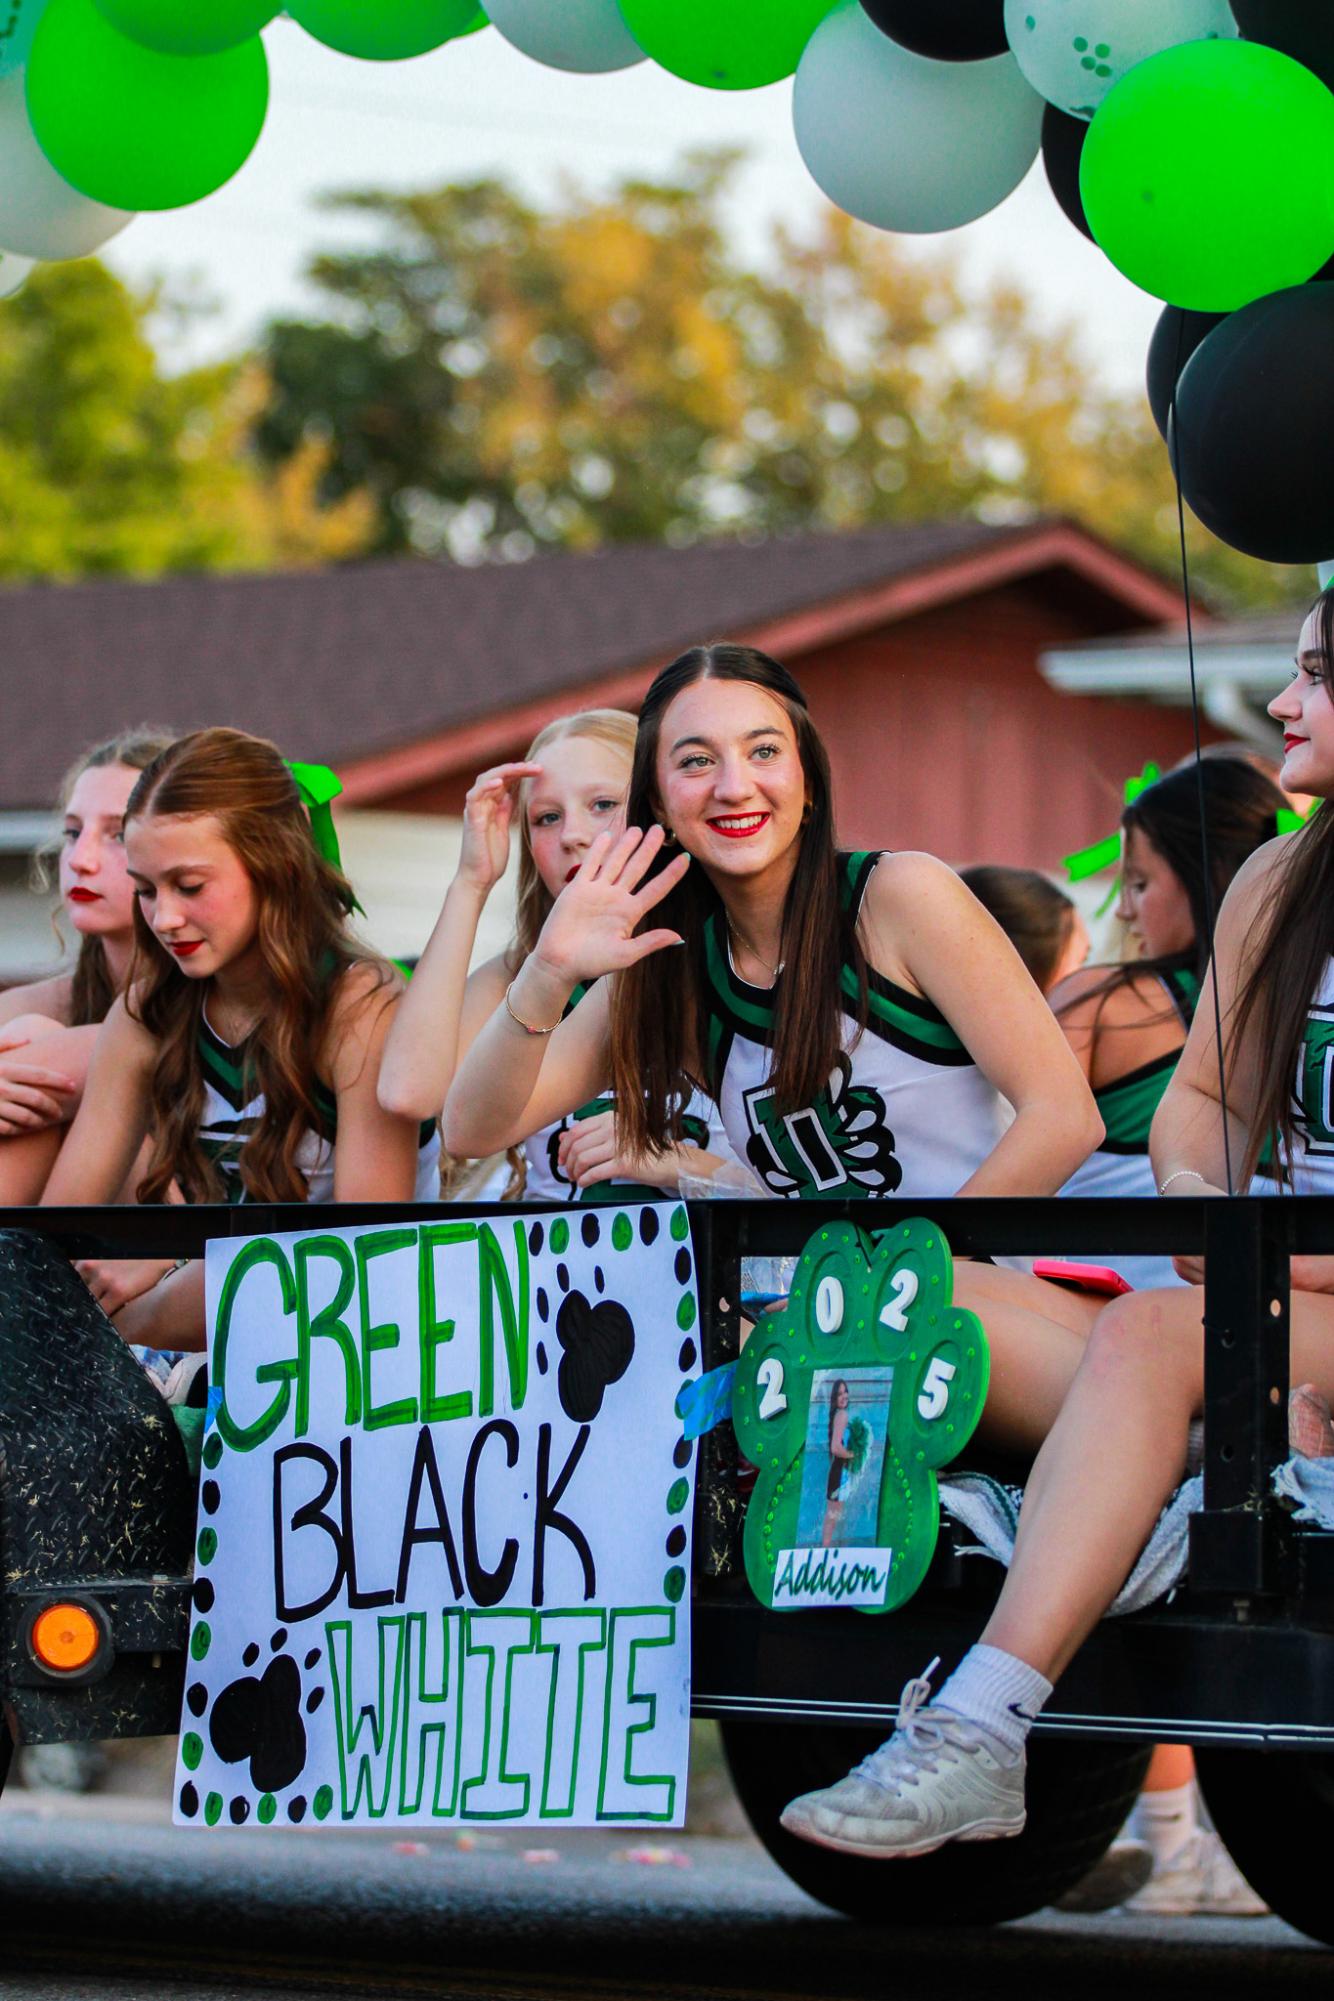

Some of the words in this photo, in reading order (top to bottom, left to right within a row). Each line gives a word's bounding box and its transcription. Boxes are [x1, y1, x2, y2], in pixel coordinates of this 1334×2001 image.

[212, 1220, 530, 1452] GREEN
[272, 1418, 596, 1623] BLACK
[774, 1547, 887, 1601] Addison
[325, 1606, 676, 1821] WHITE
